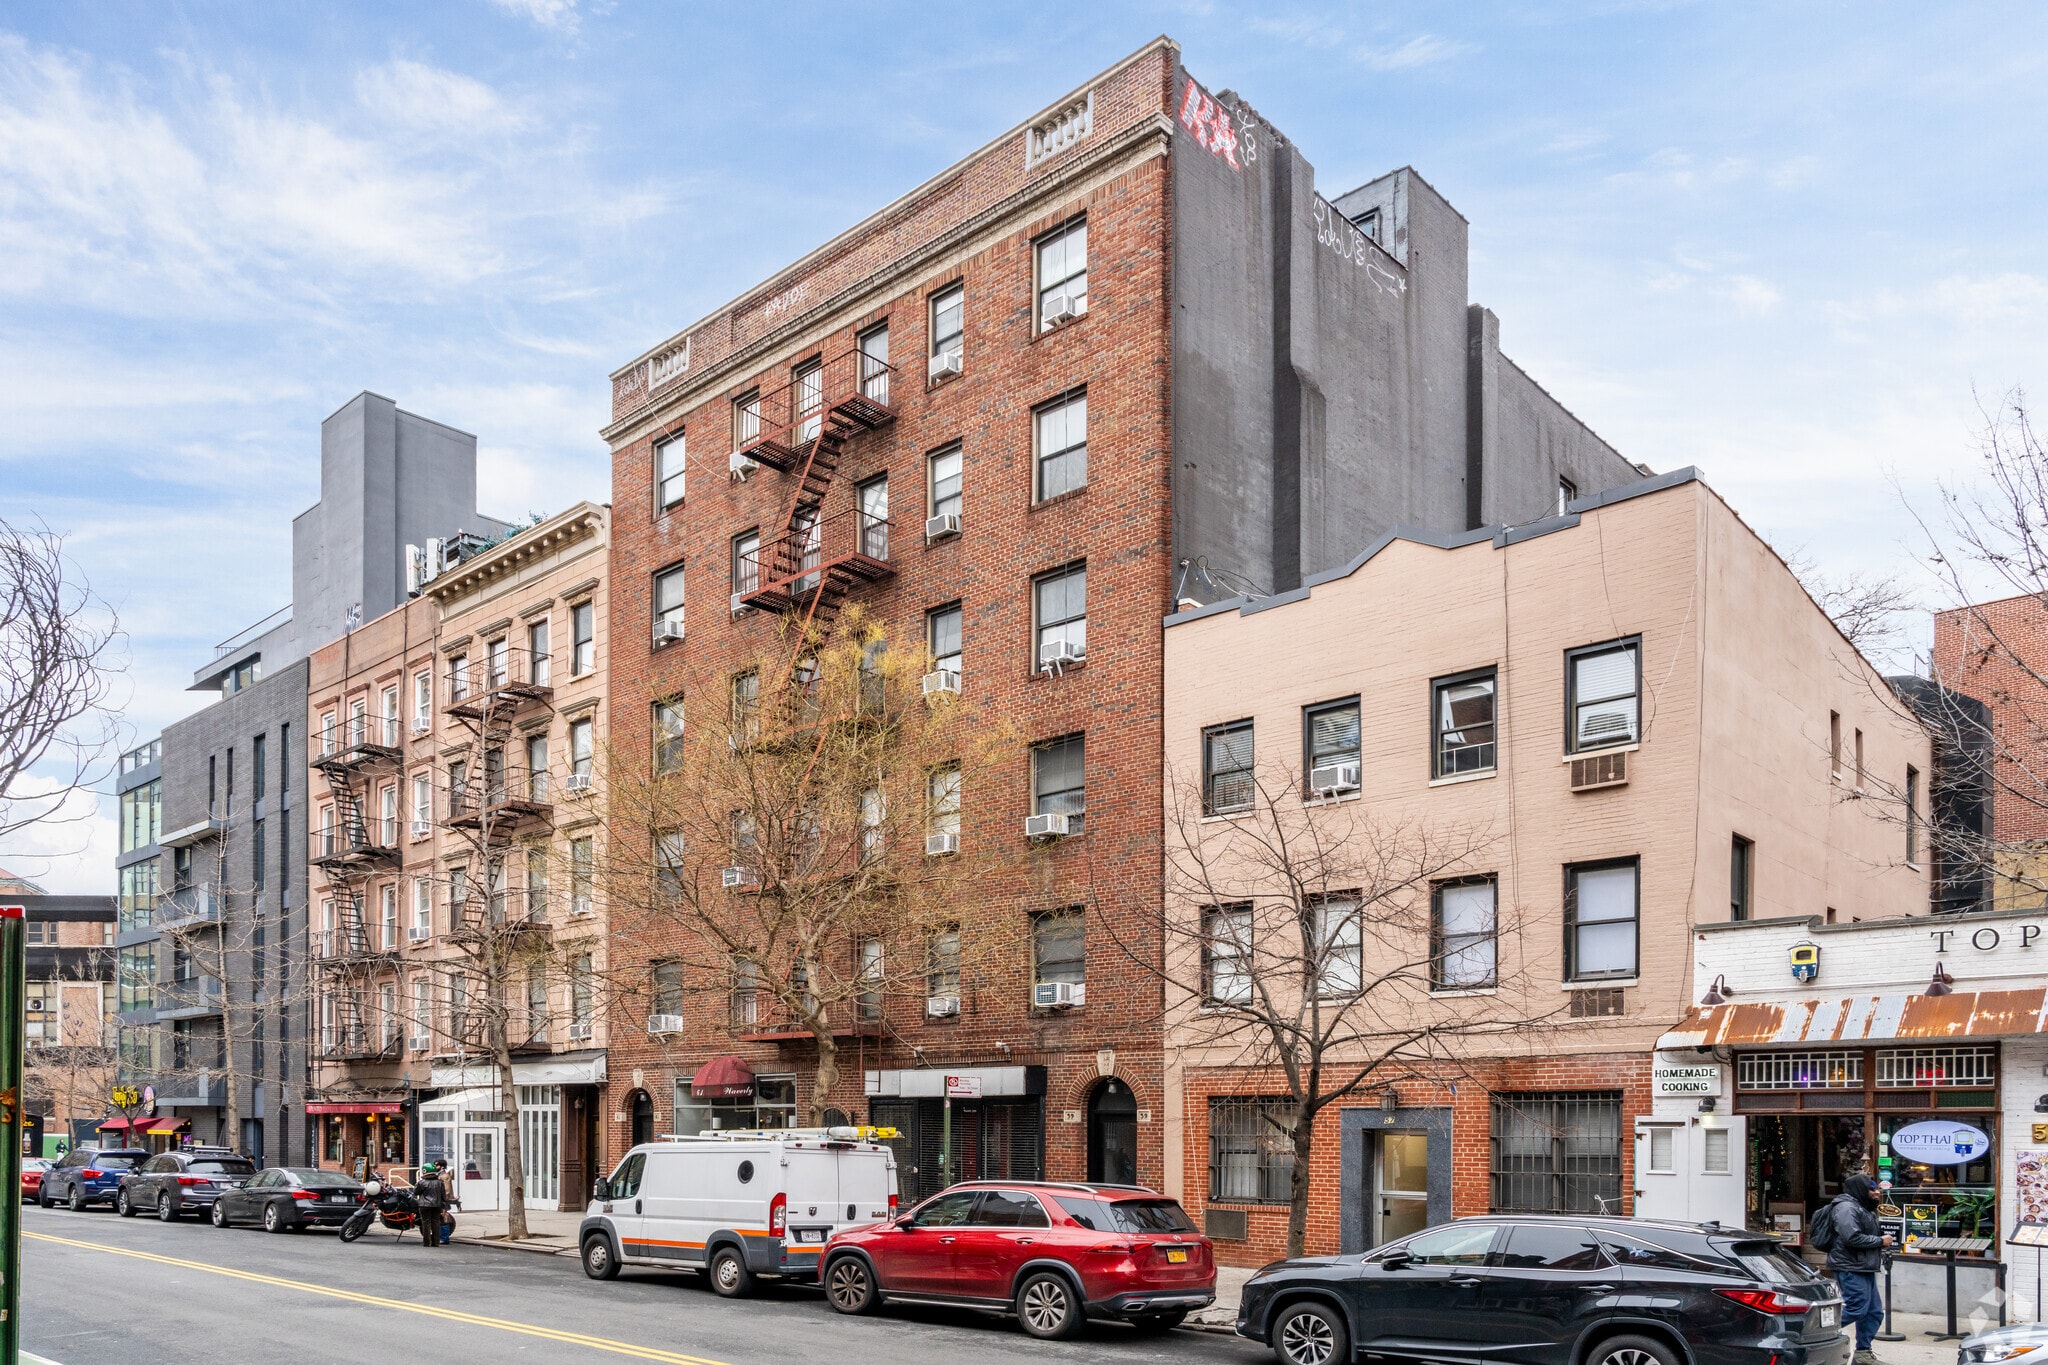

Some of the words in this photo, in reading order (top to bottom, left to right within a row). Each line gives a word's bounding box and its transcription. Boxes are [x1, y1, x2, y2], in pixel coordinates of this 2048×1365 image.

[1930, 925, 2041, 953] TOP
[1654, 1068, 1716, 1078] HOMEMADE
[1661, 1082, 1708, 1091] COOKING
[1384, 1116, 1395, 1124] 57
[2033, 1125, 2045, 1140] 5
[1898, 1134, 1921, 1145] TOP
[1921, 1134, 1951, 1145] THAI
